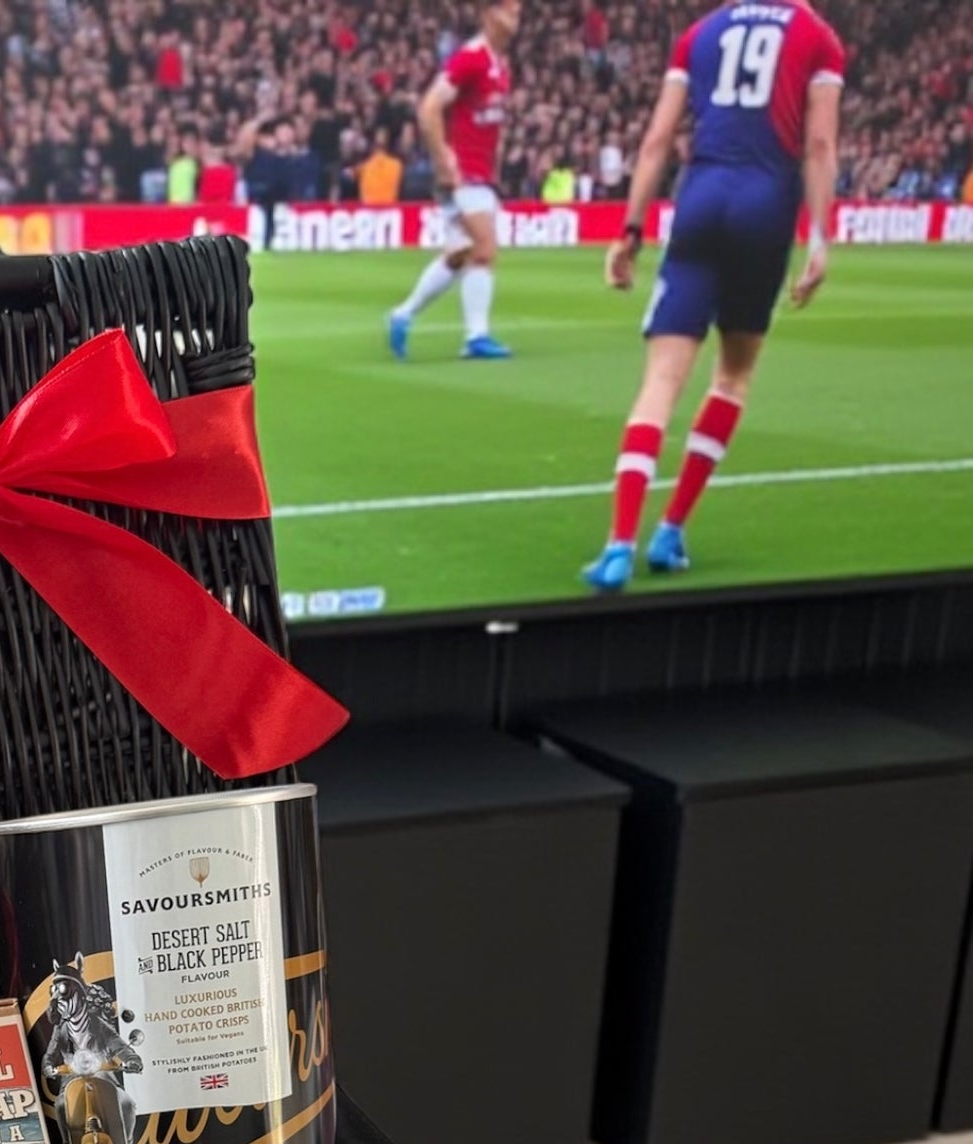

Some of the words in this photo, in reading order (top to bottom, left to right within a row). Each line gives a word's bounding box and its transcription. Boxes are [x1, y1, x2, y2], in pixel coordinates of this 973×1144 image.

[711, 24, 784, 108] 19
[138, 855, 173, 878] MASTERS
[175, 851, 185, 859] OF
[187, 847, 223, 856] FLAVOUR
[121, 882, 271, 915] SAVOURSMITHS
[152, 926, 209, 950] DESERT
[216, 920, 250, 943] SALT
[138, 960, 153, 973] AND
[157, 949, 206, 972] BLACK
[212, 941, 263, 966] PEPPER
[181, 970, 230, 983] FLAVOUR
[175, 988, 237, 1005] LUXURIOUS
[145, 1011, 177, 1022] HAND
[181, 1005, 224, 1018] COOKED
[169, 1021, 213, 1034] POTATO
[216, 1015, 249, 1028] CRISPS
[176, 1036, 205, 1045] Suitable
[219, 1031, 244, 1040] Vegans
[152, 1057, 191, 1066] STYLISHLY
[193, 1051, 234, 1062] FASHIONED
[191, 1063, 220, 1071] BRITISH
[222, 1057, 257, 1067] POTATOES
[10, 1126, 25, 1142] A
